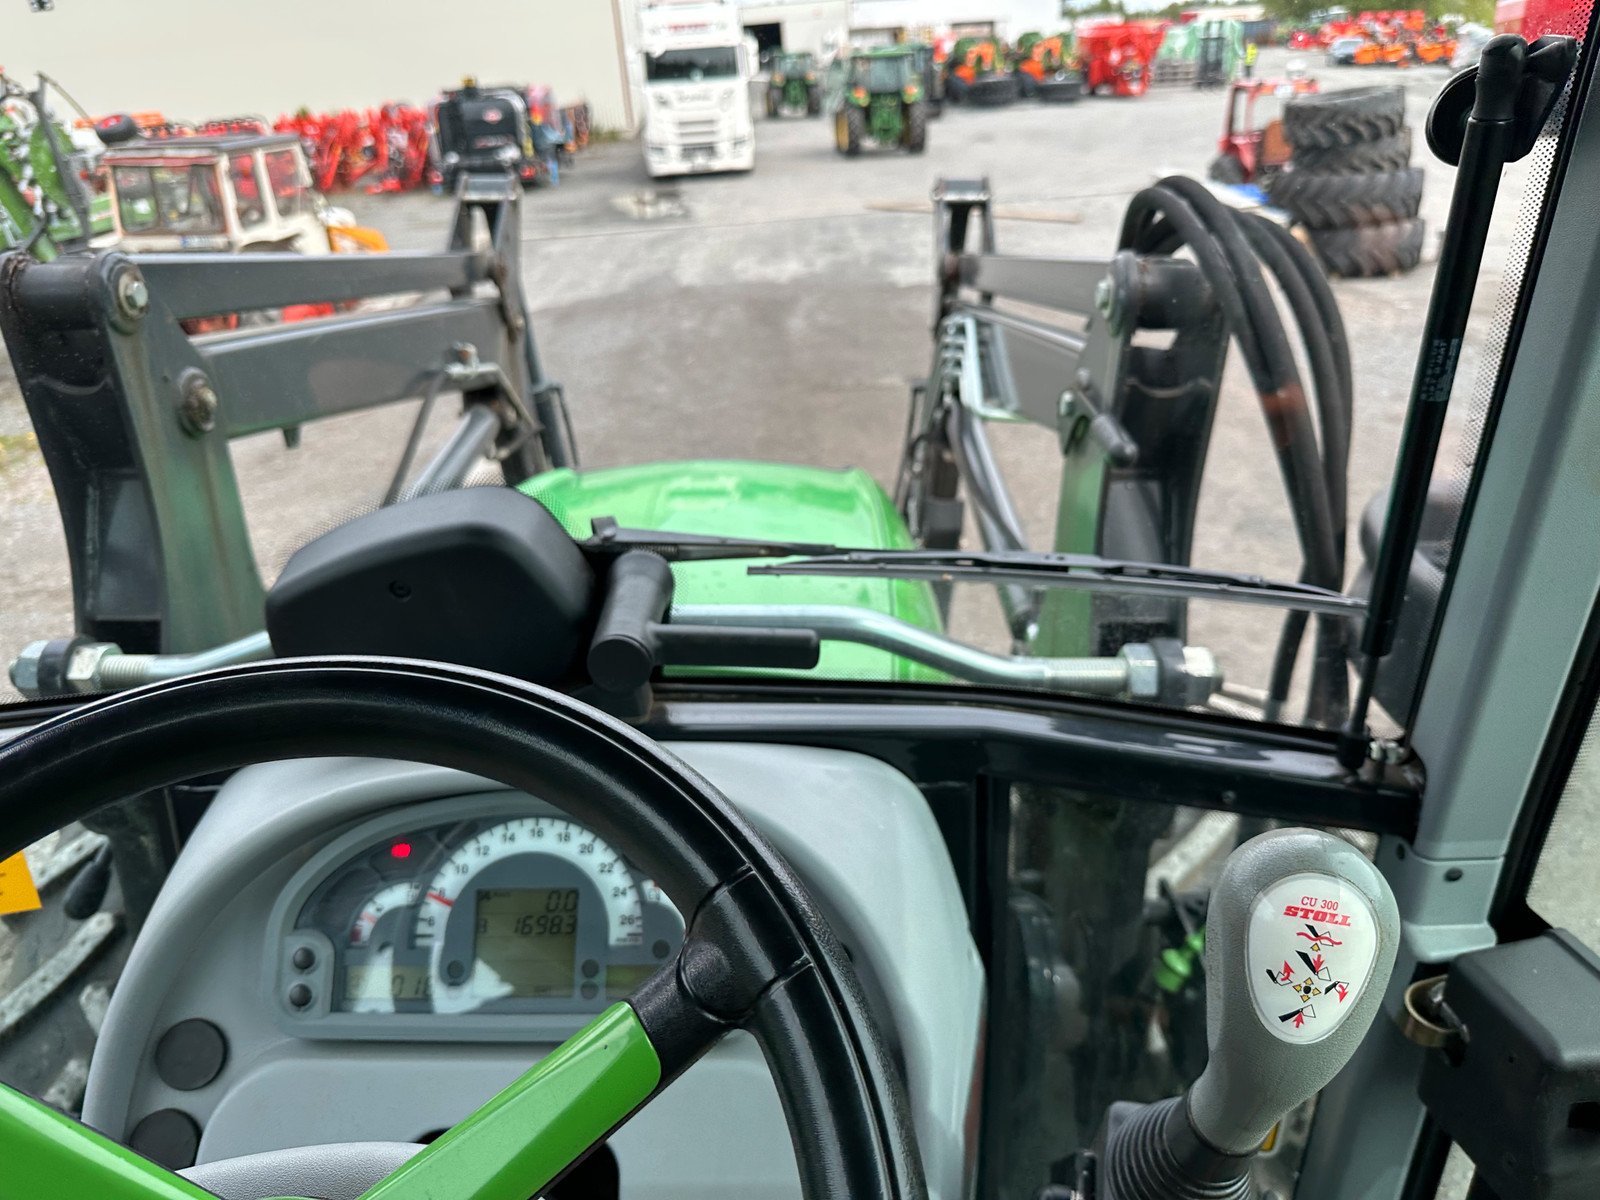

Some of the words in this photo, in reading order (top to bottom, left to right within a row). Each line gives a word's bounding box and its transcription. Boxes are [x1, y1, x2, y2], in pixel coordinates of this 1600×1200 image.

[502, 832, 516, 843] 14
[530, 828, 544, 838] 16
[557, 832, 571, 842] 18
[476, 845, 490, 856] 12
[579, 843, 594, 854] 20
[455, 863, 469, 875] 10
[600, 862, 614, 873] 22
[613, 886, 628, 897] 24
[1301, 896, 1318, 907] CU
[1320, 899, 1339, 911] 300
[620, 914, 635, 925] 26
[1283, 905, 1351, 926] STOLL
